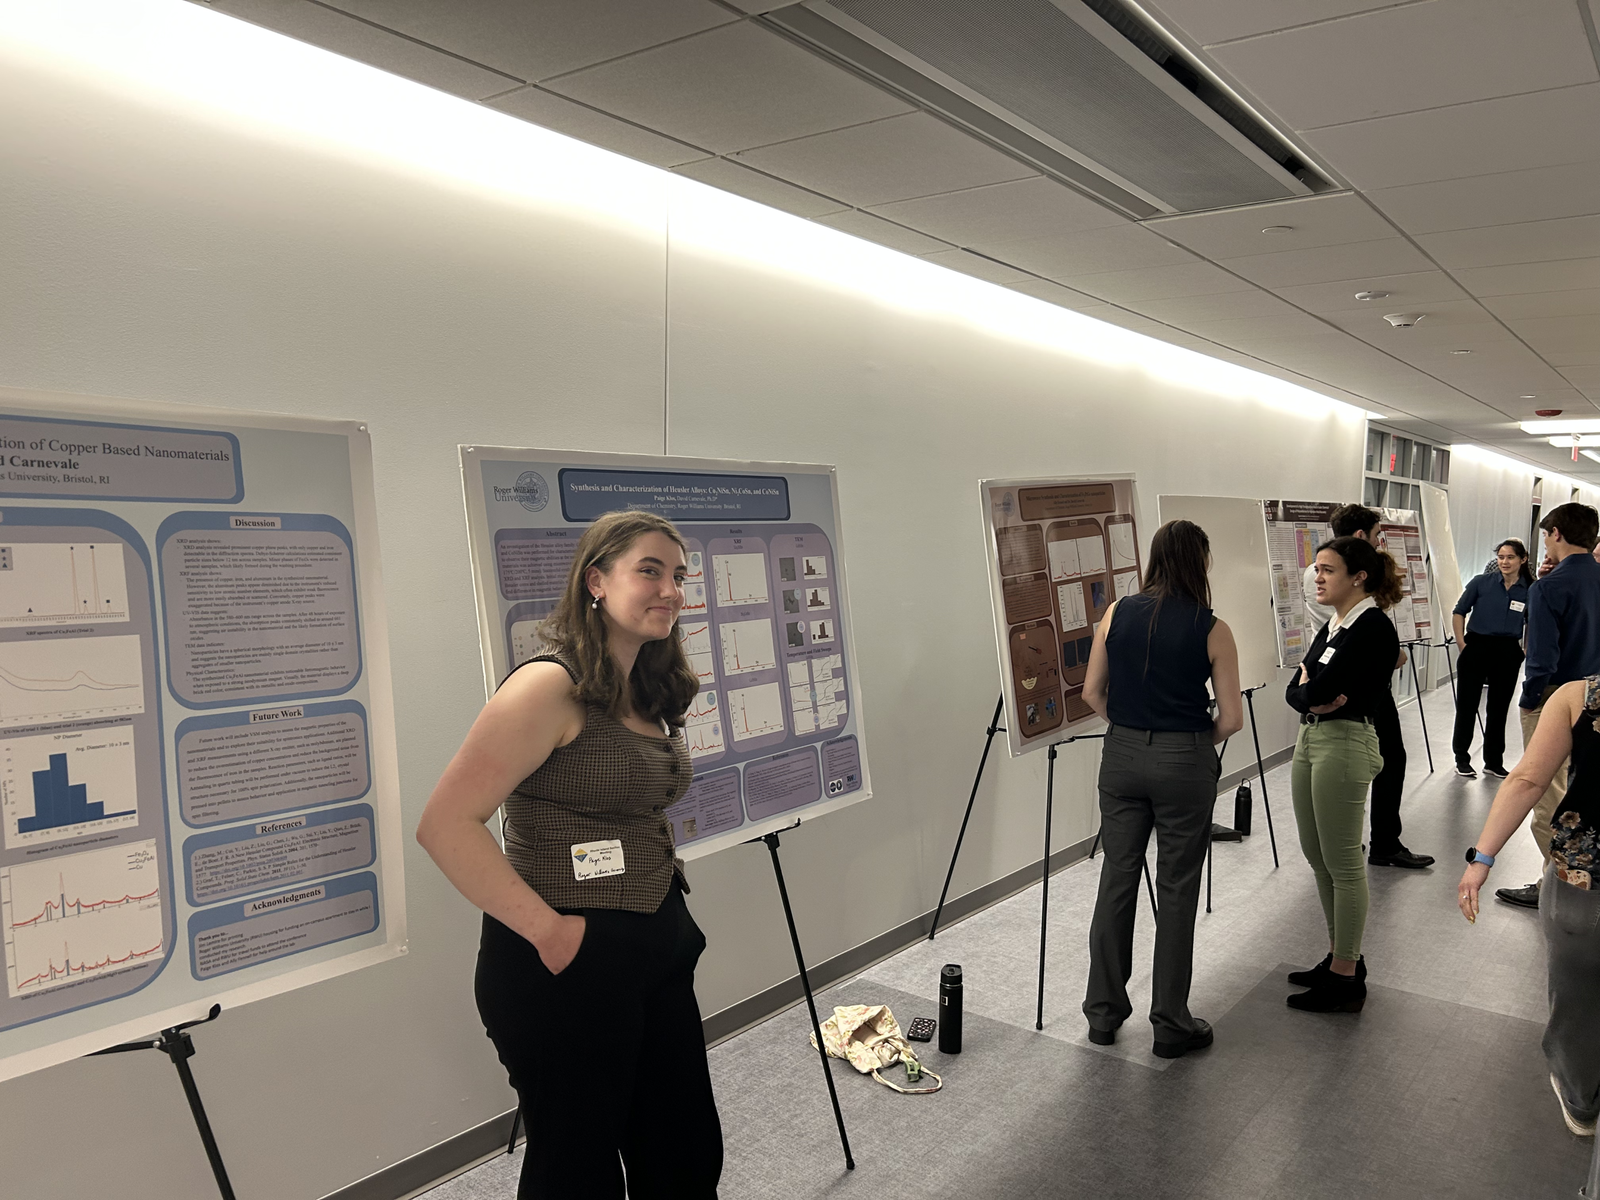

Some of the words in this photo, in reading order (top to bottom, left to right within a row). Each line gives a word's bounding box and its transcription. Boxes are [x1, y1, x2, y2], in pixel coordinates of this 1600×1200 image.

[30, 438, 46, 451] of
[48, 439, 98, 456] Copper
[102, 442, 140, 456] Based
[144, 445, 230, 462] Nanomaterials
[10, 456, 80, 470] Carnevale
[8, 472, 60, 484] University,
[63, 474, 97, 484] Bristol,
[99, 476, 110, 484] RI
[494, 486, 512, 495] Roger
[512, 486, 539, 494] Williams
[570, 483, 600, 493] Synthesis
[601, 484, 612, 492] and
[614, 484, 662, 493] Characterization
[691, 486, 708, 495] Alloys:
[235, 519, 276, 527] Discussion
[253, 712, 279, 721] Future
[280, 709, 302, 717] Work
[261, 820, 302, 833] References
[251, 889, 321, 912] Acknowledgments
[228, 933, 243, 941] printing
[230, 937, 249, 945] University
